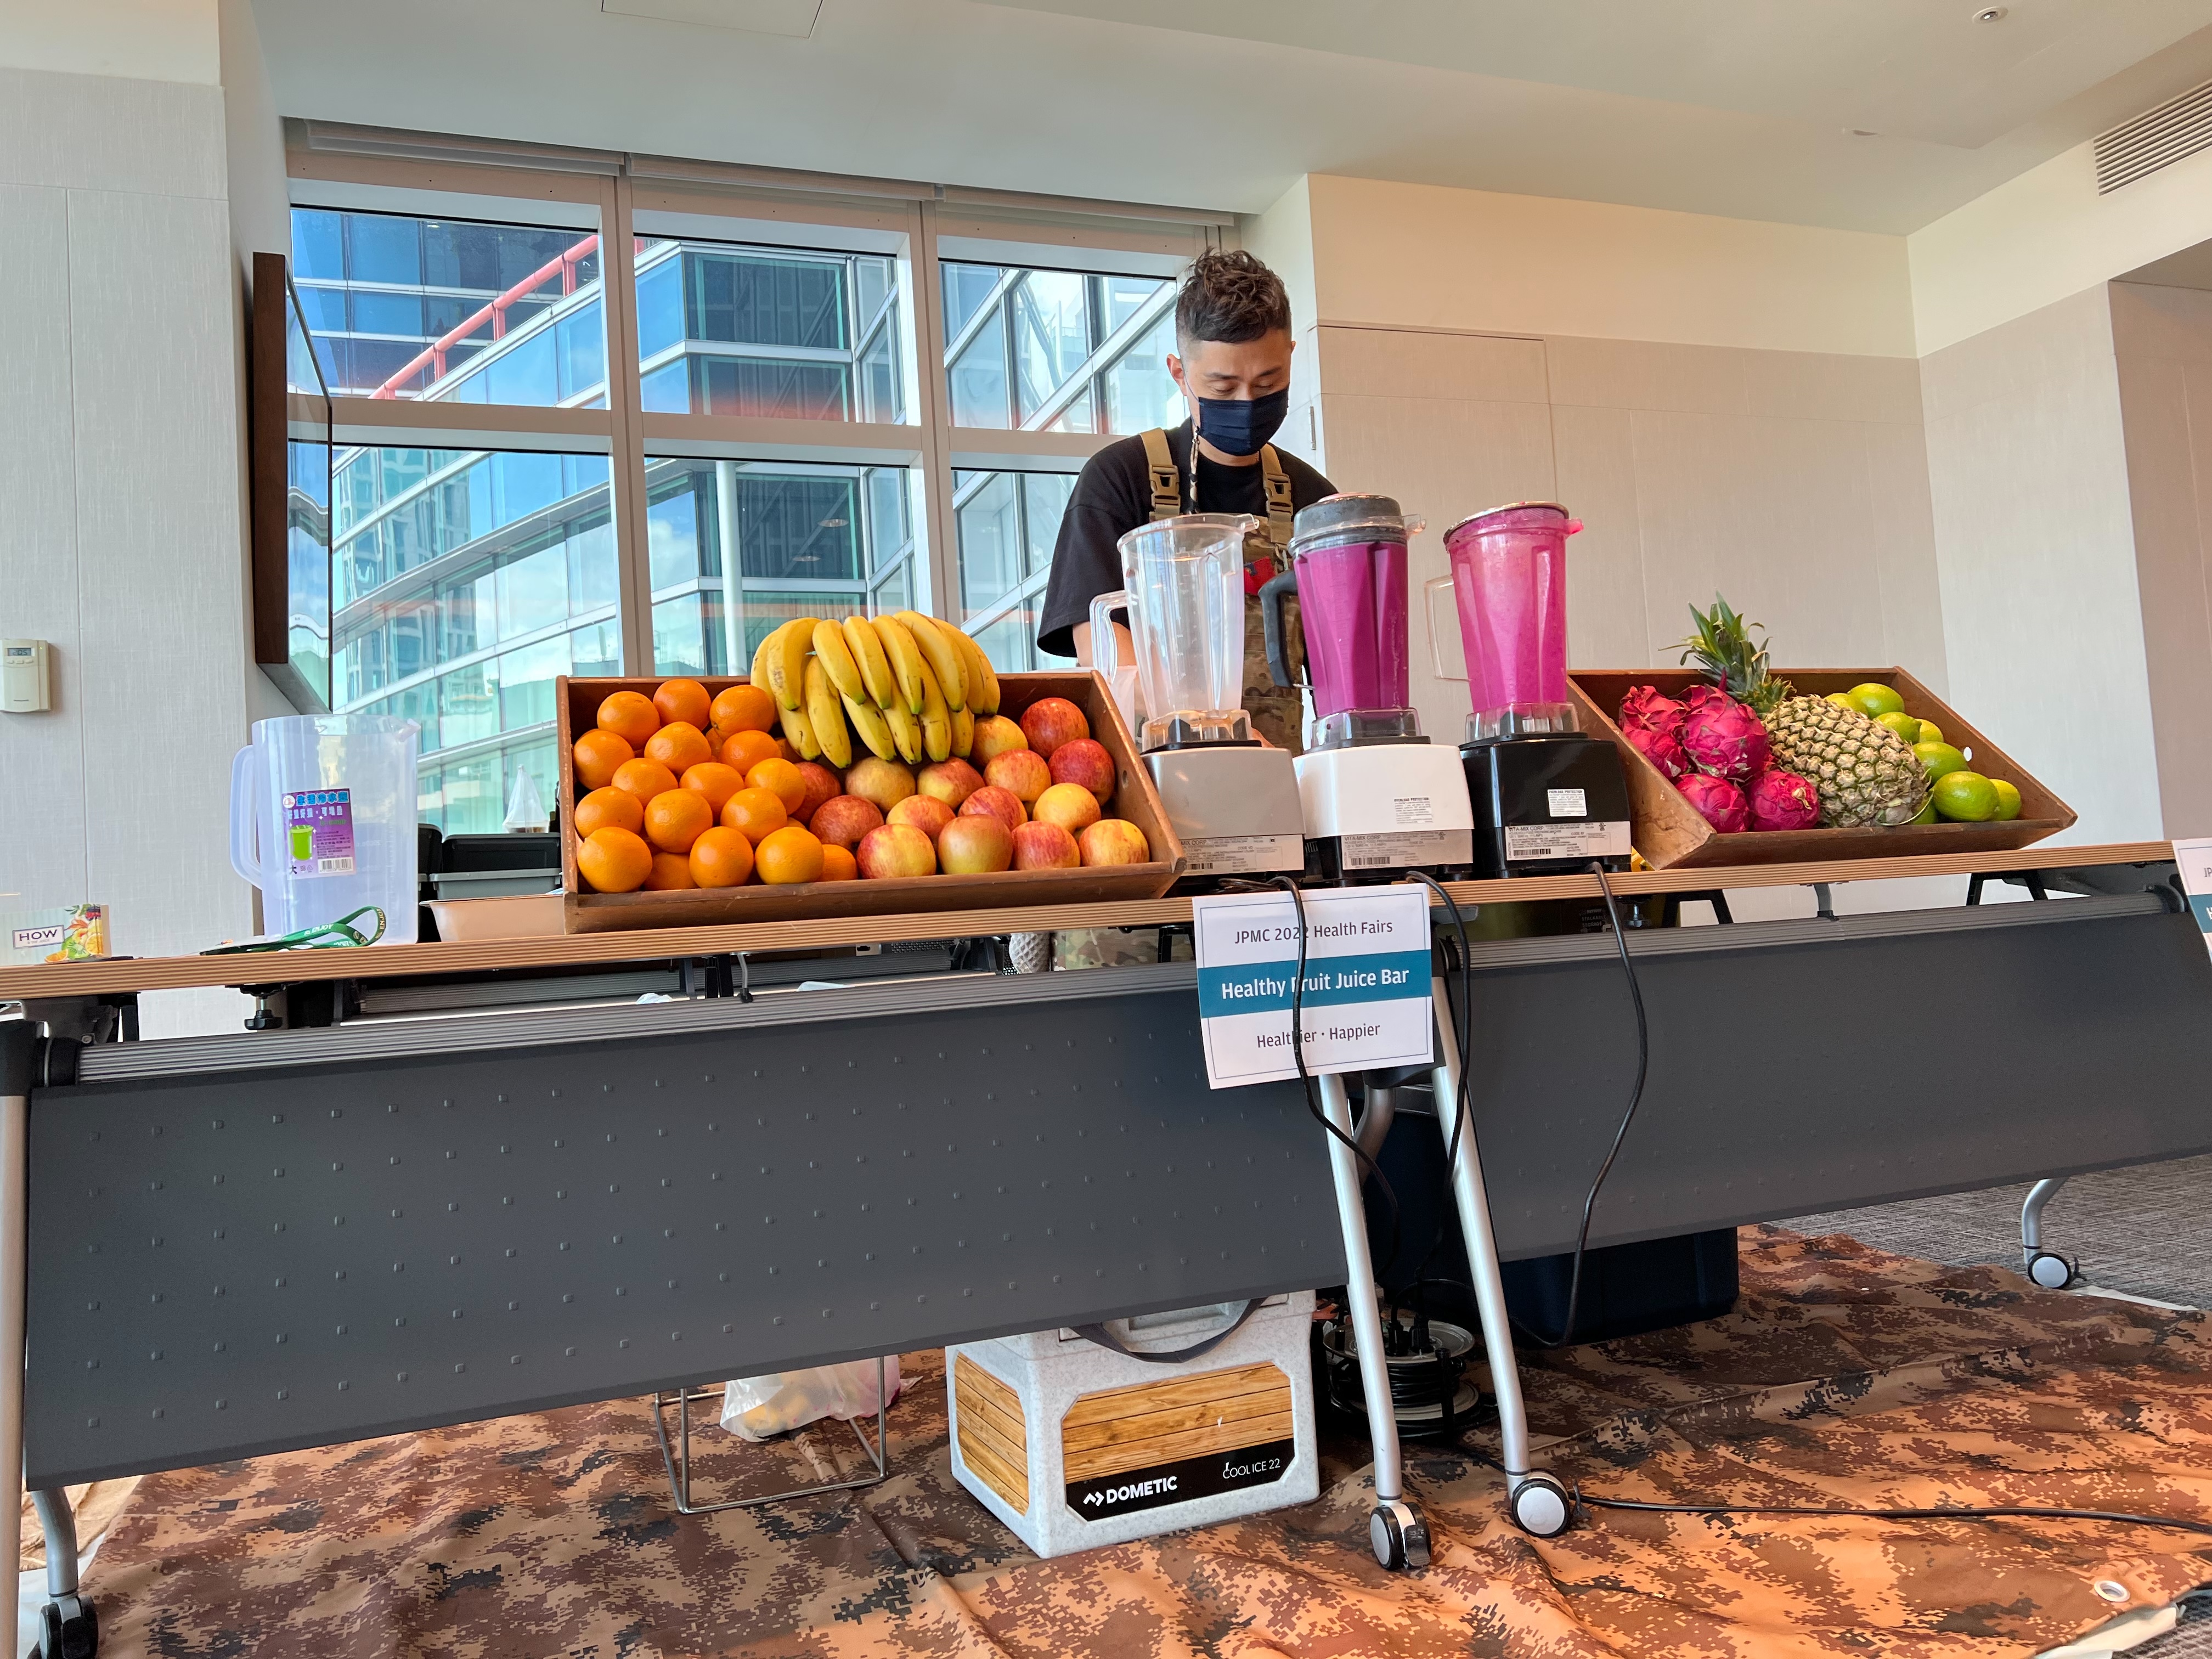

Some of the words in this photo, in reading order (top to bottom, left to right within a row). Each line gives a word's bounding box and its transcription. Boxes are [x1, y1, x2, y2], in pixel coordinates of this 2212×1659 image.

[19, 929, 58, 941] HOW
[311, 924, 334, 933] ENJOY
[1235, 929, 1270, 944] JPMC
[1314, 922, 1357, 938] Health
[1361, 919, 1393, 934] Fairs
[1222, 977, 1286, 1000] Healthy
[1335, 970, 1376, 989] Juice
[1381, 969, 1409, 985] Bar
[1257, 1029, 1317, 1048] Healtier
[1329, 1023, 1381, 1041] Happier
[1222, 1462, 1251, 1479] COOL
[1252, 1460, 1267, 1473] ICE
[1268, 1458, 1280, 1470] 22
[1106, 1476, 1178, 1504] DOMETIC
